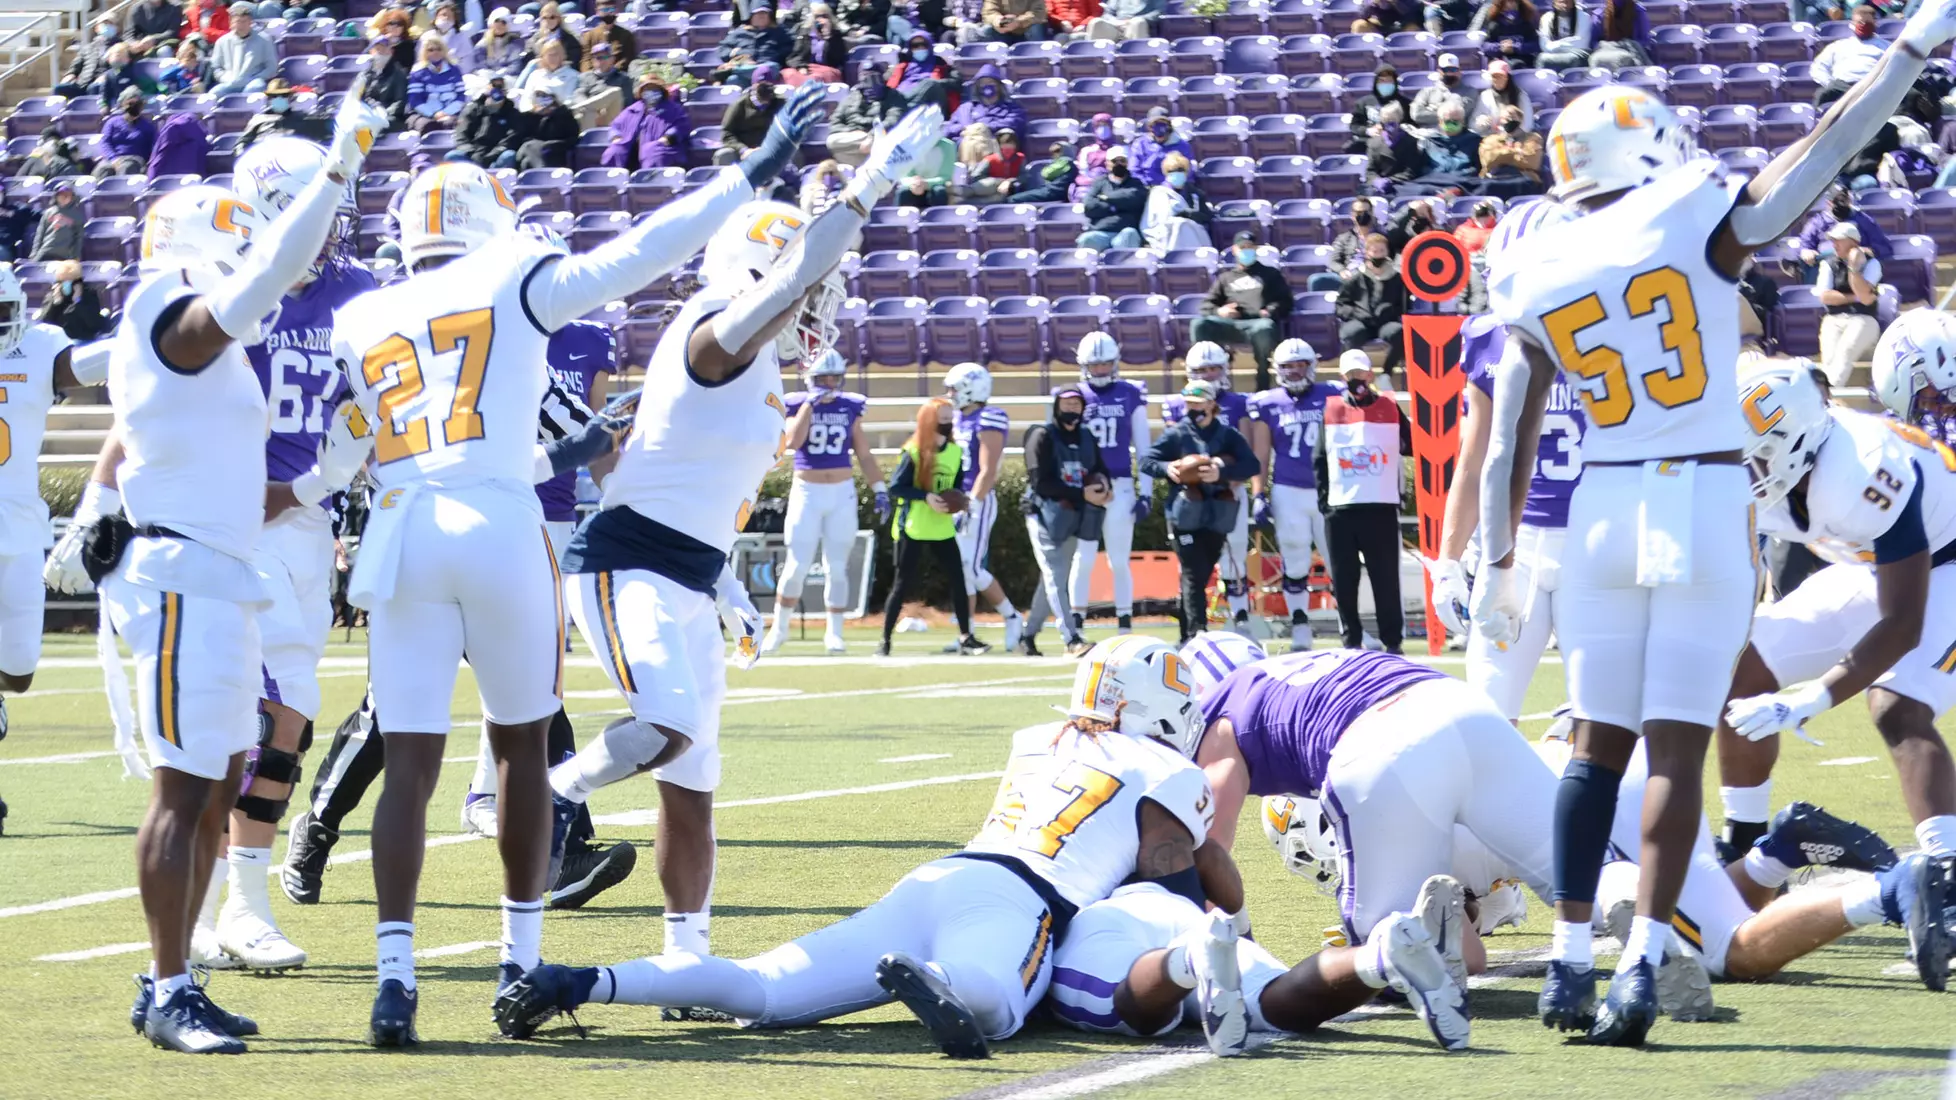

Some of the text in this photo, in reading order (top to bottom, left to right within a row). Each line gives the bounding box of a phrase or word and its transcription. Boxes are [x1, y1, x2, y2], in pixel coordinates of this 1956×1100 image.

[1539, 264, 1709, 429] 53
[268, 348, 341, 434] 67
[361, 305, 496, 468] 27
[1741, 381, 1787, 436] C
[807, 424, 847, 455] 93
[1088, 418, 1118, 449] 91
[1534, 414, 1582, 482] 3
[1862, 467, 1904, 512] 92
[1799, 841, 1845, 858] adidas
